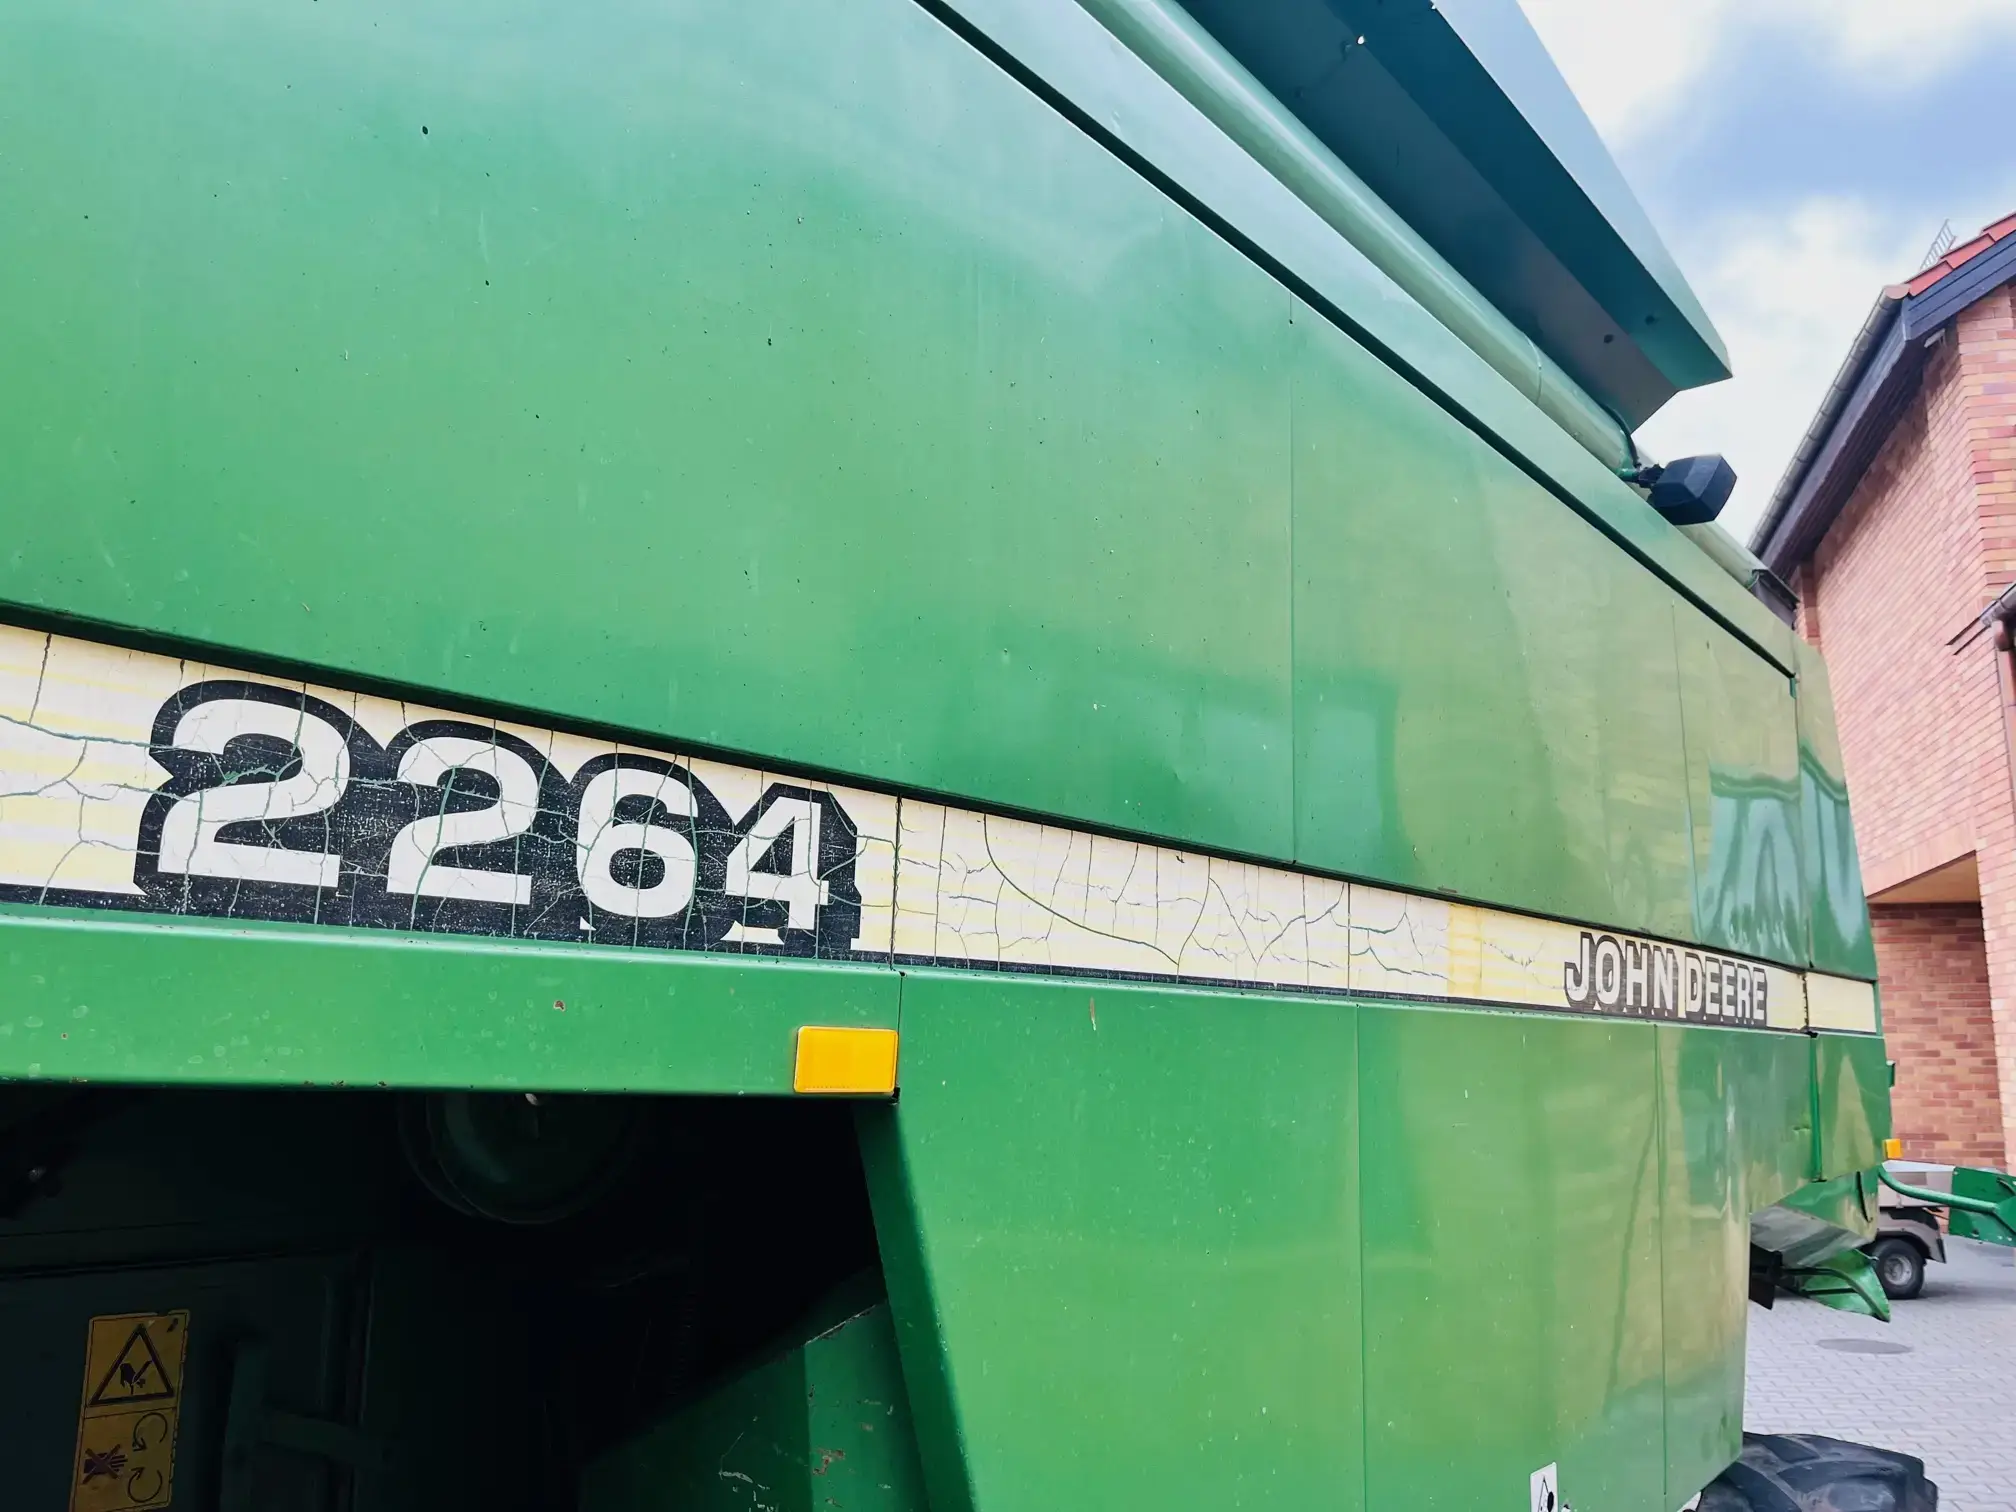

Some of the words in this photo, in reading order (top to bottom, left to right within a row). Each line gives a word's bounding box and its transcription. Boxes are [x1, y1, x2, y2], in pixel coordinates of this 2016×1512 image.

[154, 693, 834, 935] 2264
[1565, 934, 1676, 1012] JOHN
[1684, 954, 1767, 1021] DEERE
